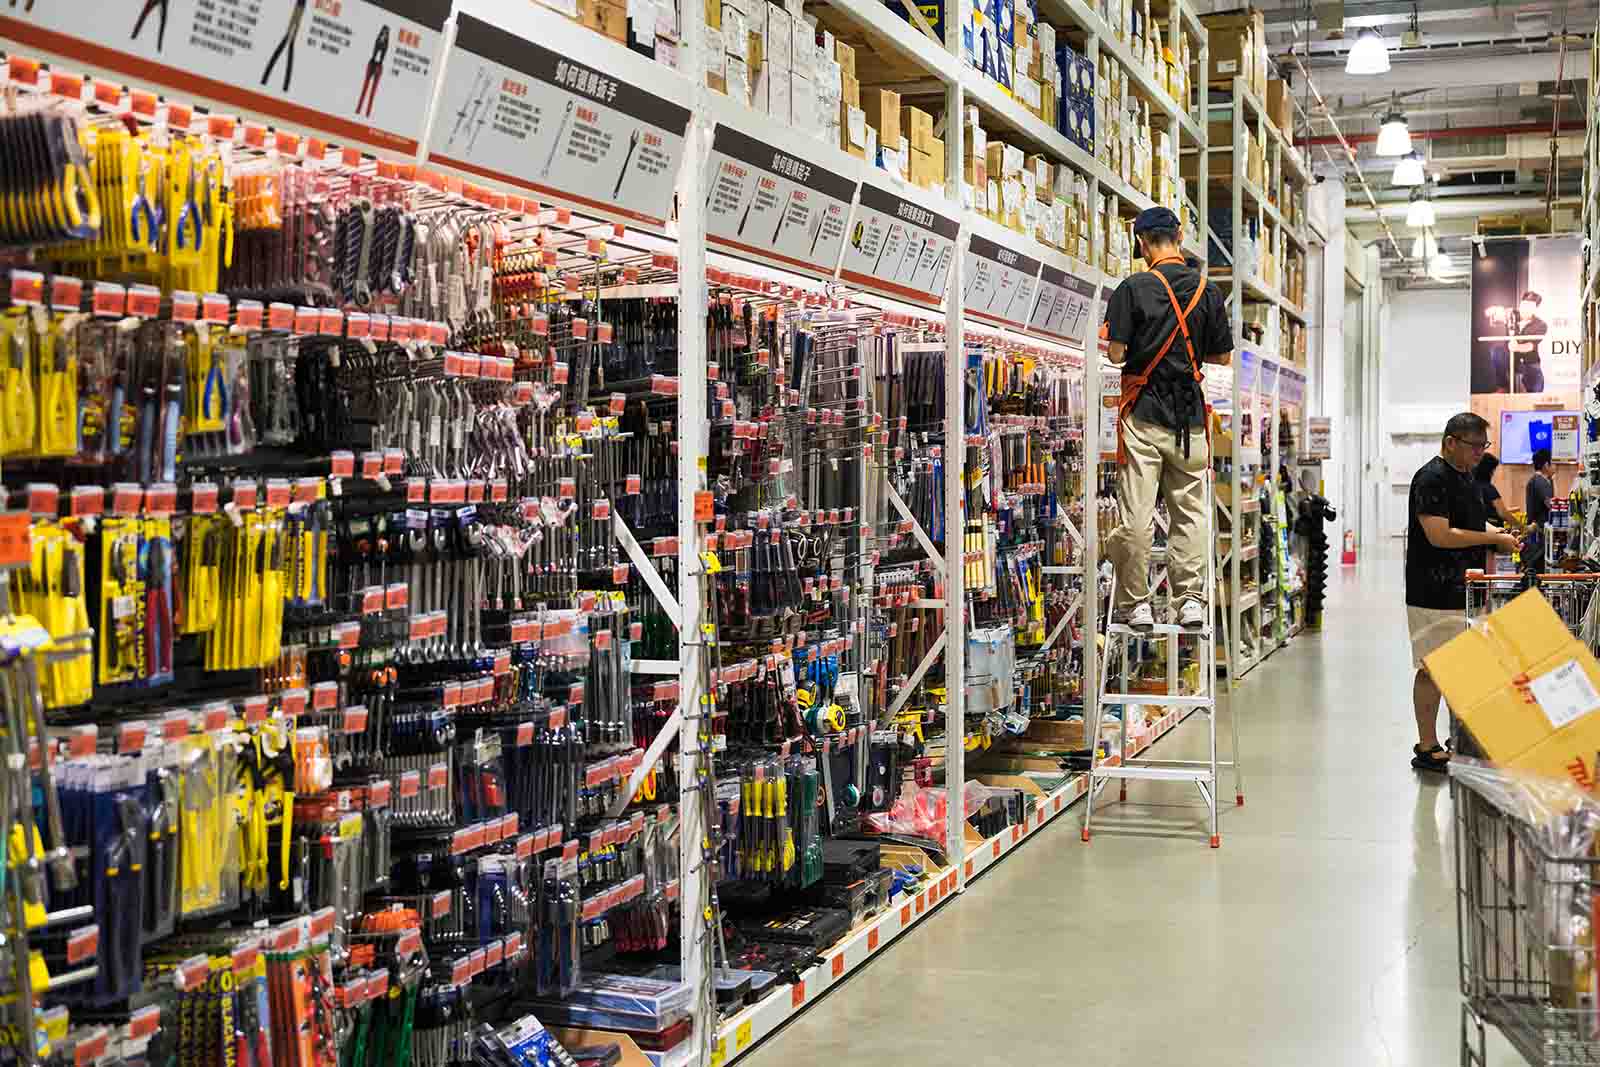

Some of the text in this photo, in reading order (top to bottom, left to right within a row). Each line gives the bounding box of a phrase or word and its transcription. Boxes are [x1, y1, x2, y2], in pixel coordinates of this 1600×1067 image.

[554, 60, 619, 103] 如何選購扳手
[771, 152, 811, 182] 如何選購起子
[1551, 340, 1582, 355] DIY
